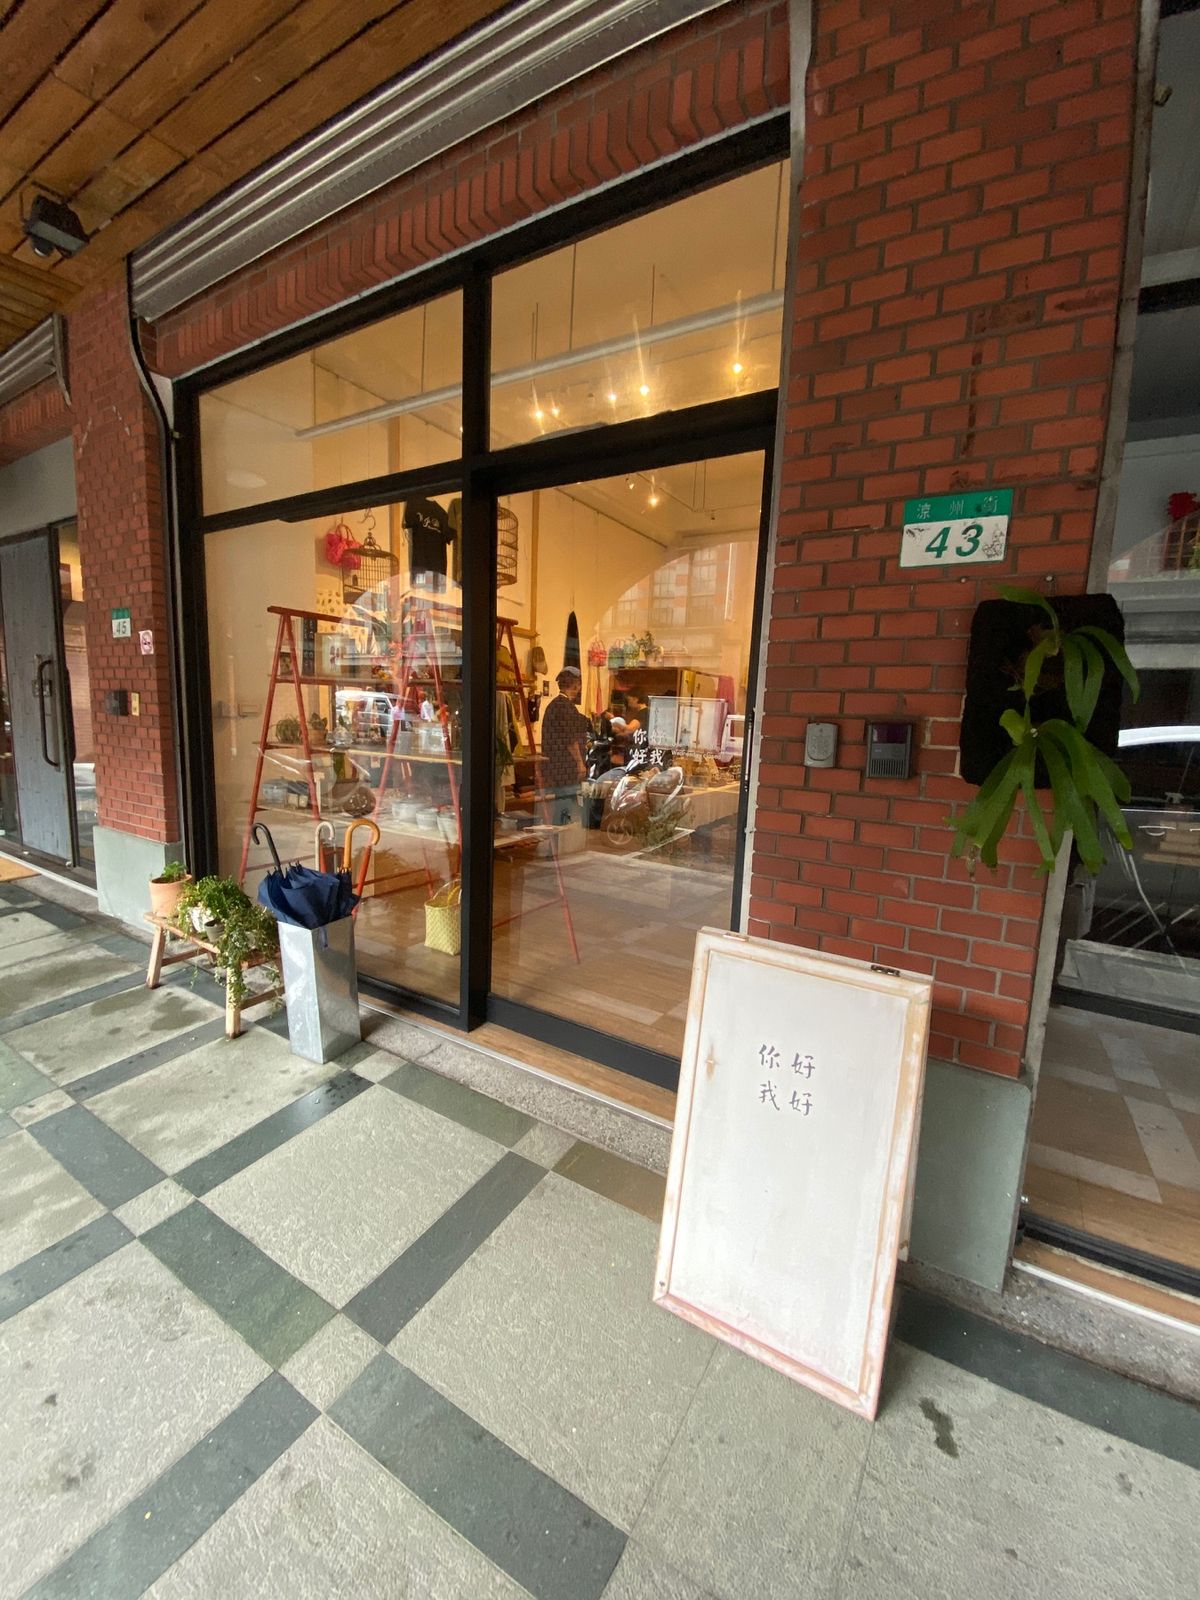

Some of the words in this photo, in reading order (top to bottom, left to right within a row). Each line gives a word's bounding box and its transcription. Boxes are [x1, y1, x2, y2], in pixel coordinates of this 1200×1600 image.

[925, 524, 983, 558] 43
[758, 1044, 815, 1079] 你好
[758, 1080, 813, 1116] 我好
